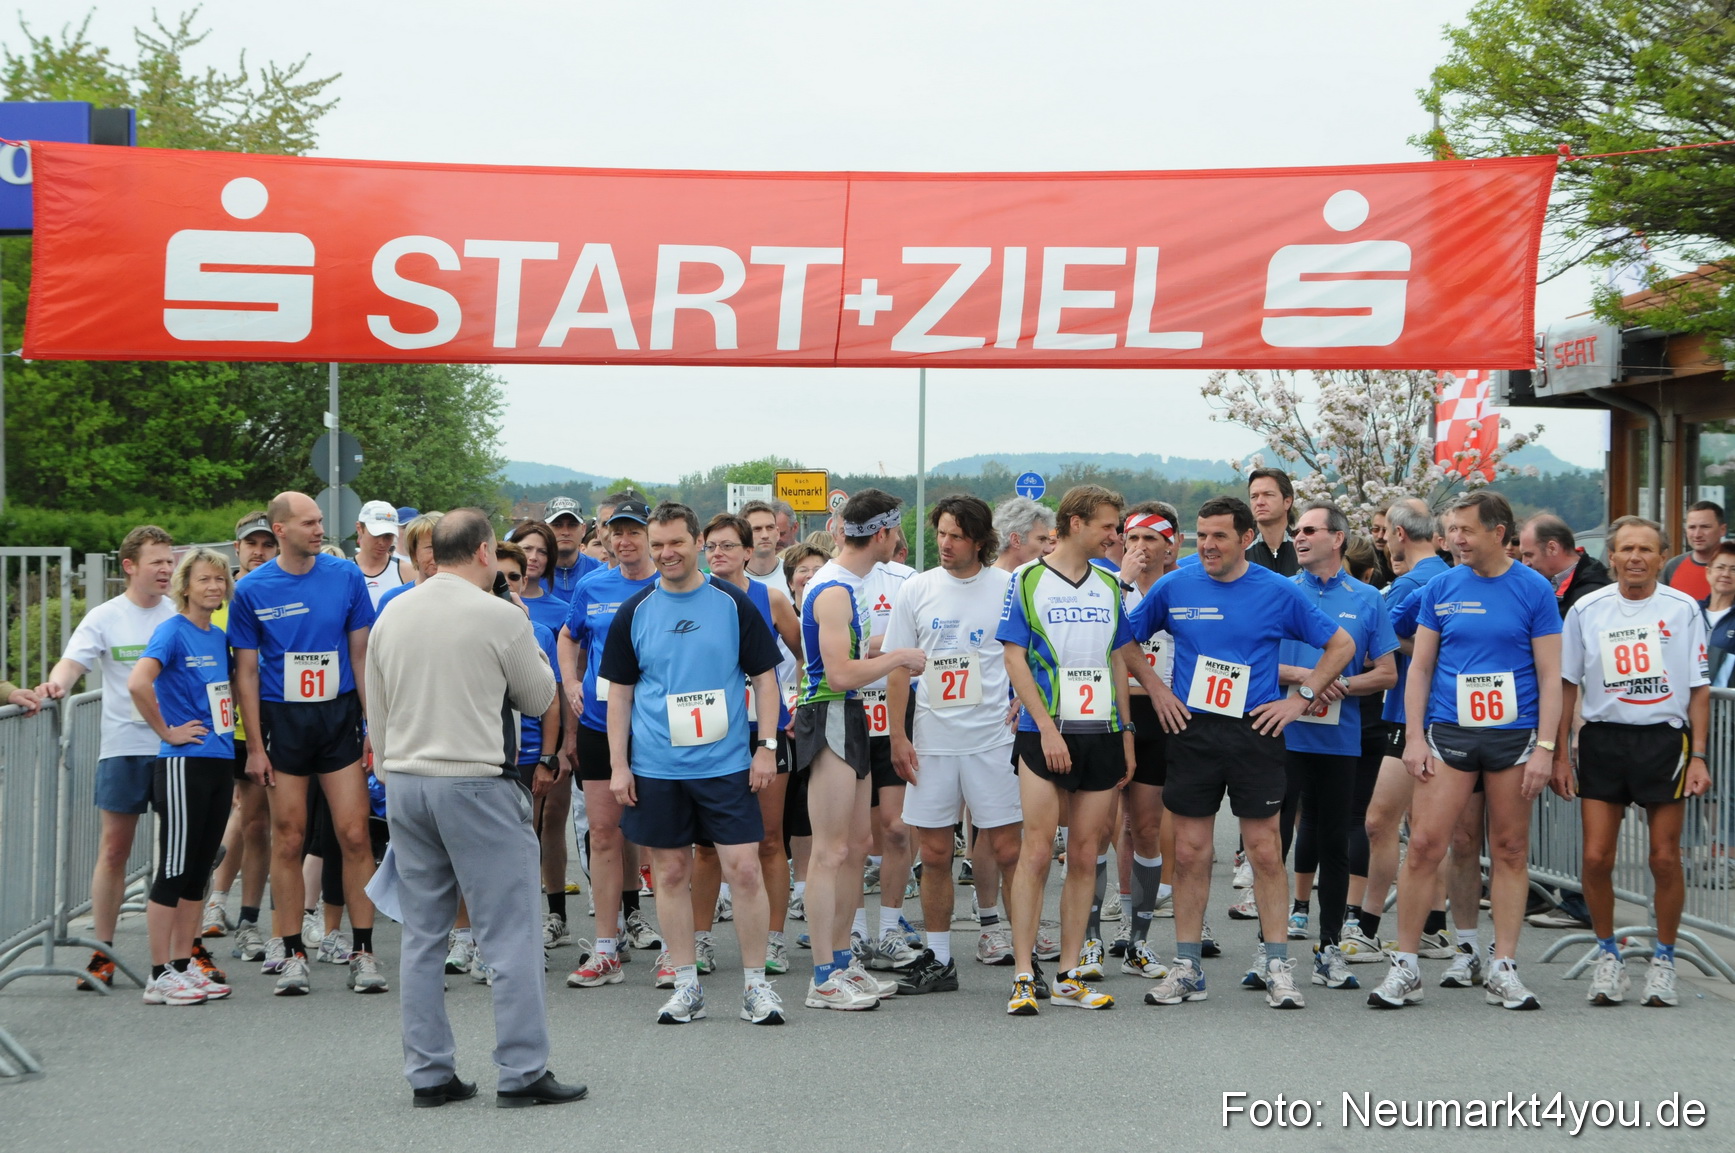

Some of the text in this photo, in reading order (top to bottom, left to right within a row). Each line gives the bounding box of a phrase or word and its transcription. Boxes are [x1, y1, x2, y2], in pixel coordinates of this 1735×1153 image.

[1554, 336, 1597, 369] SEAT
[781, 487, 822, 496] Neumarkt
[1048, 607, 1111, 624] BOCK
[1609, 630, 1635, 638] MEYER
[933, 658, 958, 666] MEYER
[1205, 661, 1230, 671] MEYER
[1614, 642, 1650, 675] 86
[300, 669, 325, 698] 61
[941, 670, 969, 700] 27
[1205, 675, 1233, 708] 16
[676, 694, 703, 703] MEYER
[1079, 684, 1094, 715] 2
[1470, 690, 1504, 721] 66
[691, 707, 703, 738] 1
